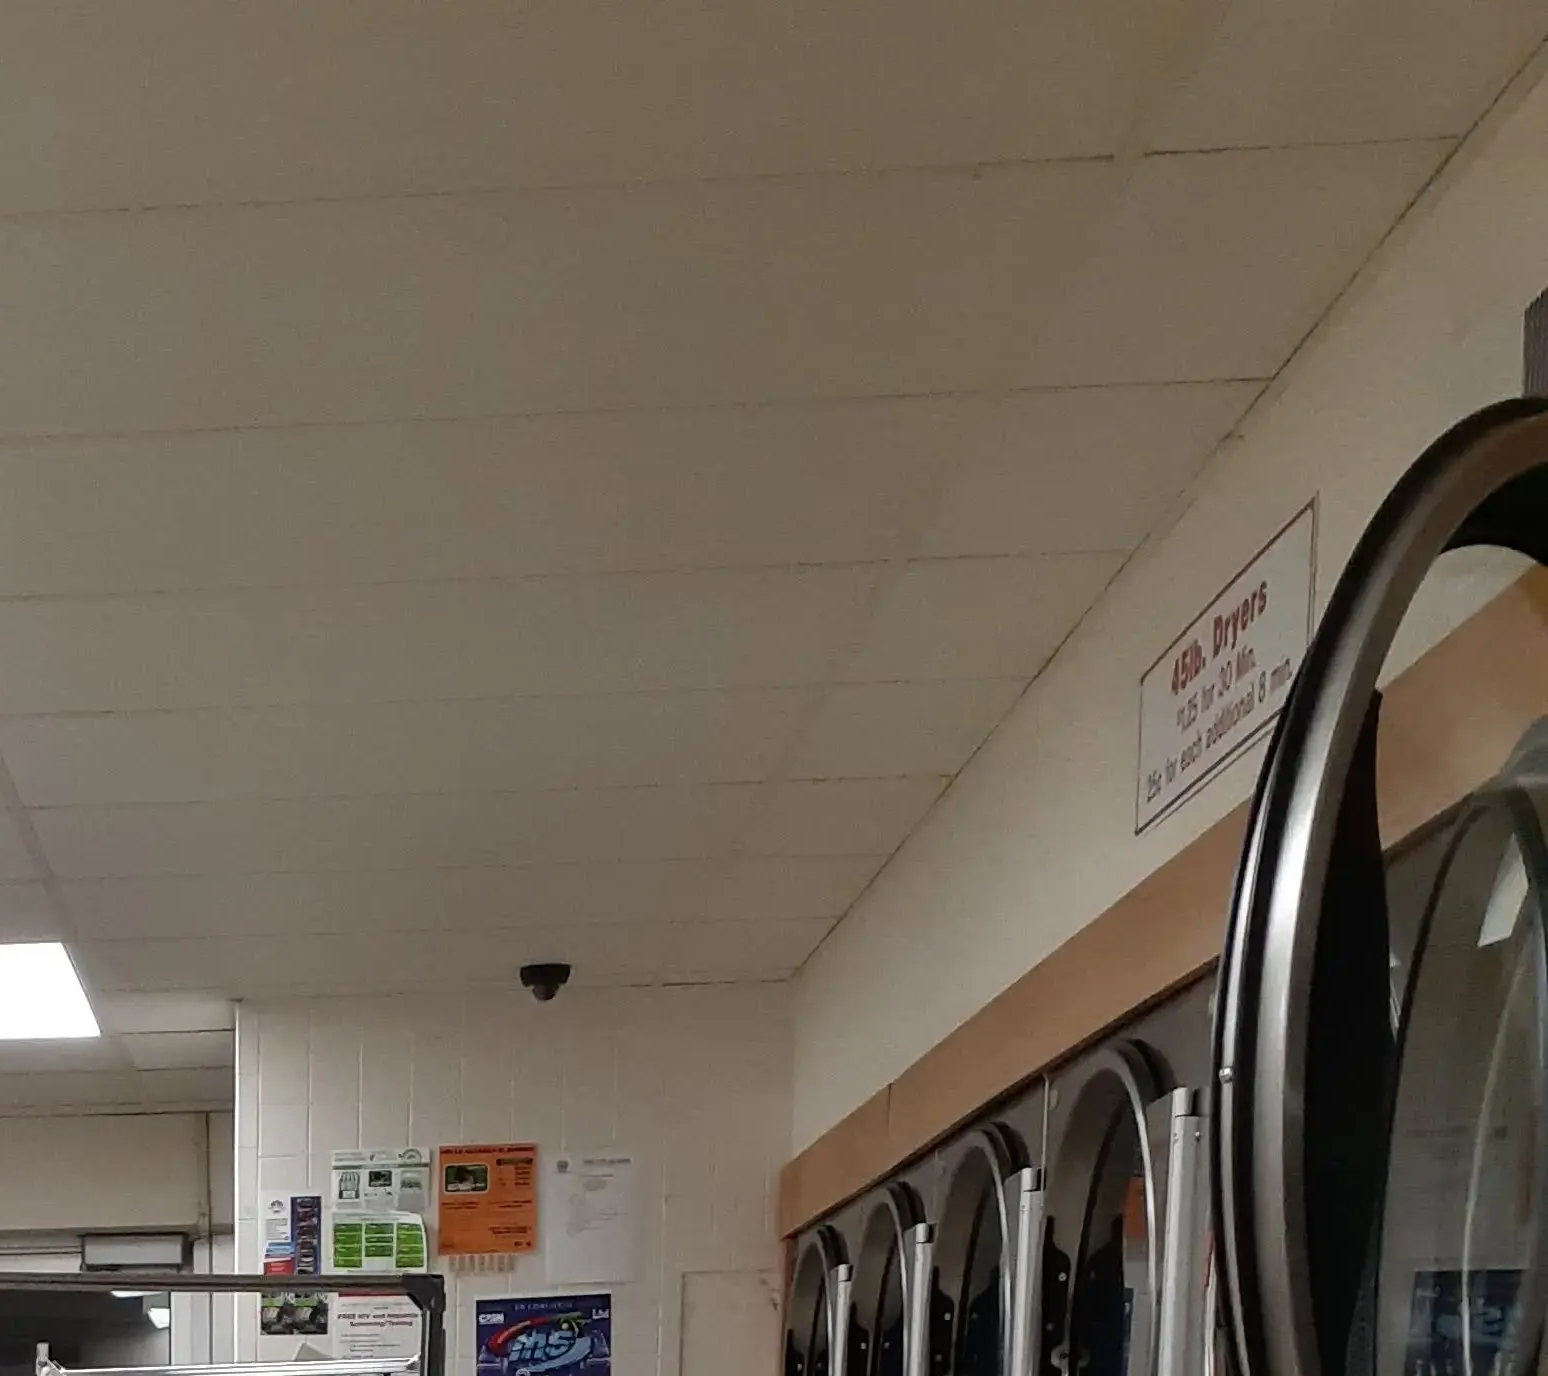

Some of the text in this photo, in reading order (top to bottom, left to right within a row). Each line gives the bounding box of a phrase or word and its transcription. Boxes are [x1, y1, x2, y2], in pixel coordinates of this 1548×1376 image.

[1170, 580, 1268, 696] 45lb. Dryers
[1180, 734, 1203, 773] each
[1205, 684, 1255, 750] additional
